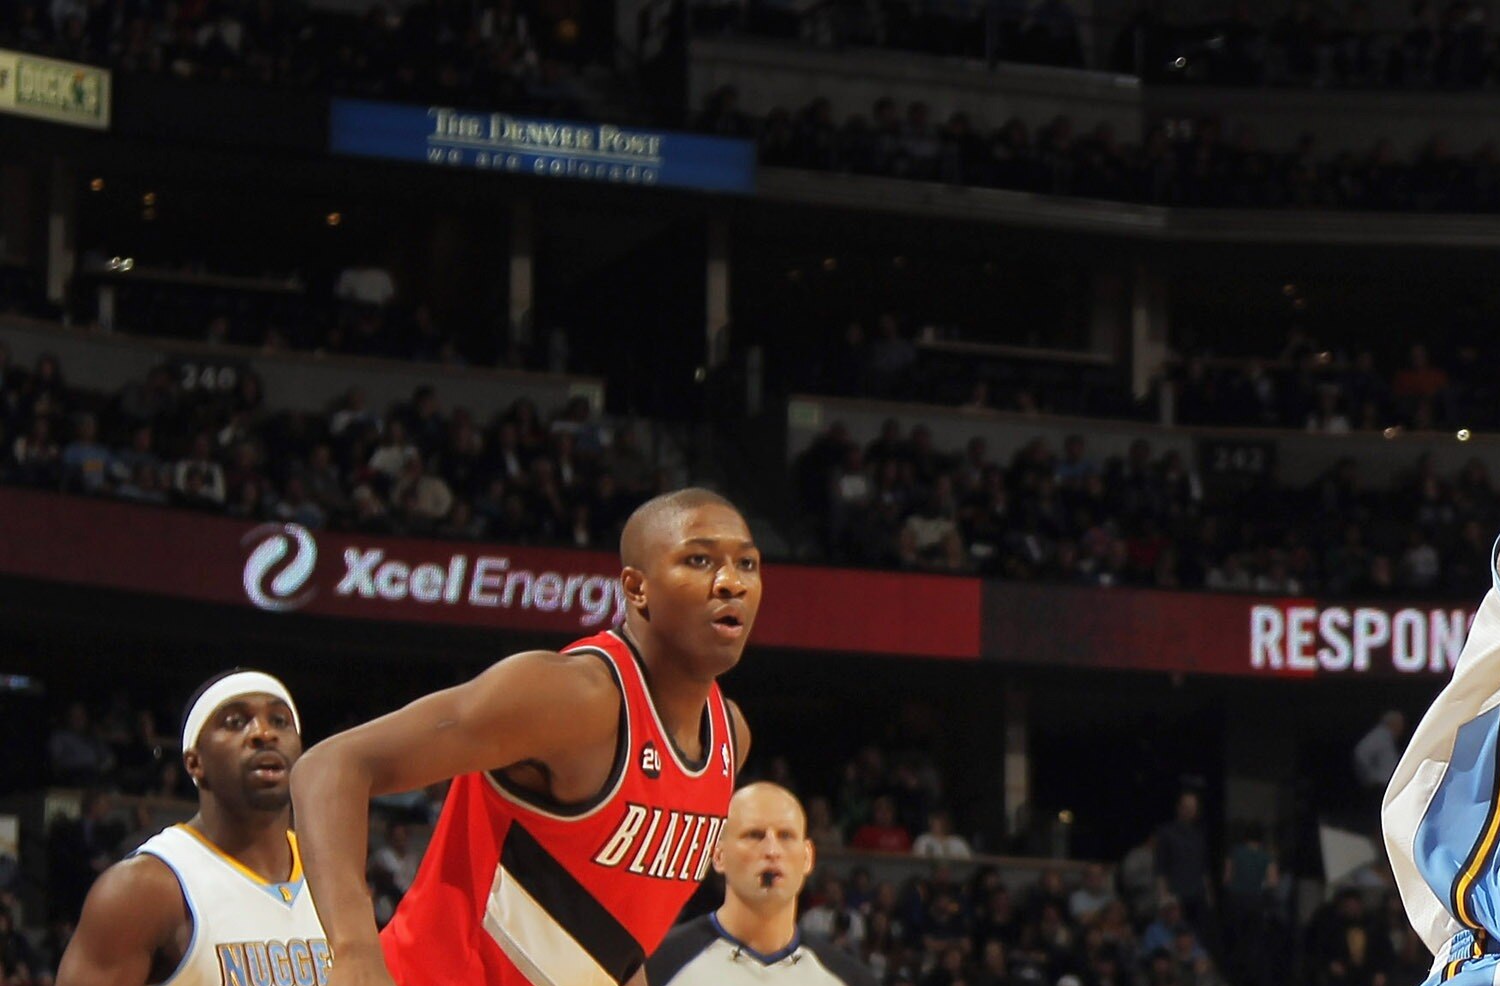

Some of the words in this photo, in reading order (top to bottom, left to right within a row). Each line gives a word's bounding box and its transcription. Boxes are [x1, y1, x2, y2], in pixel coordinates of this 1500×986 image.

[534, 158, 657, 184] colorado
[1250, 604, 1476, 674] RESPON
[594, 802, 728, 882] BLAZER
